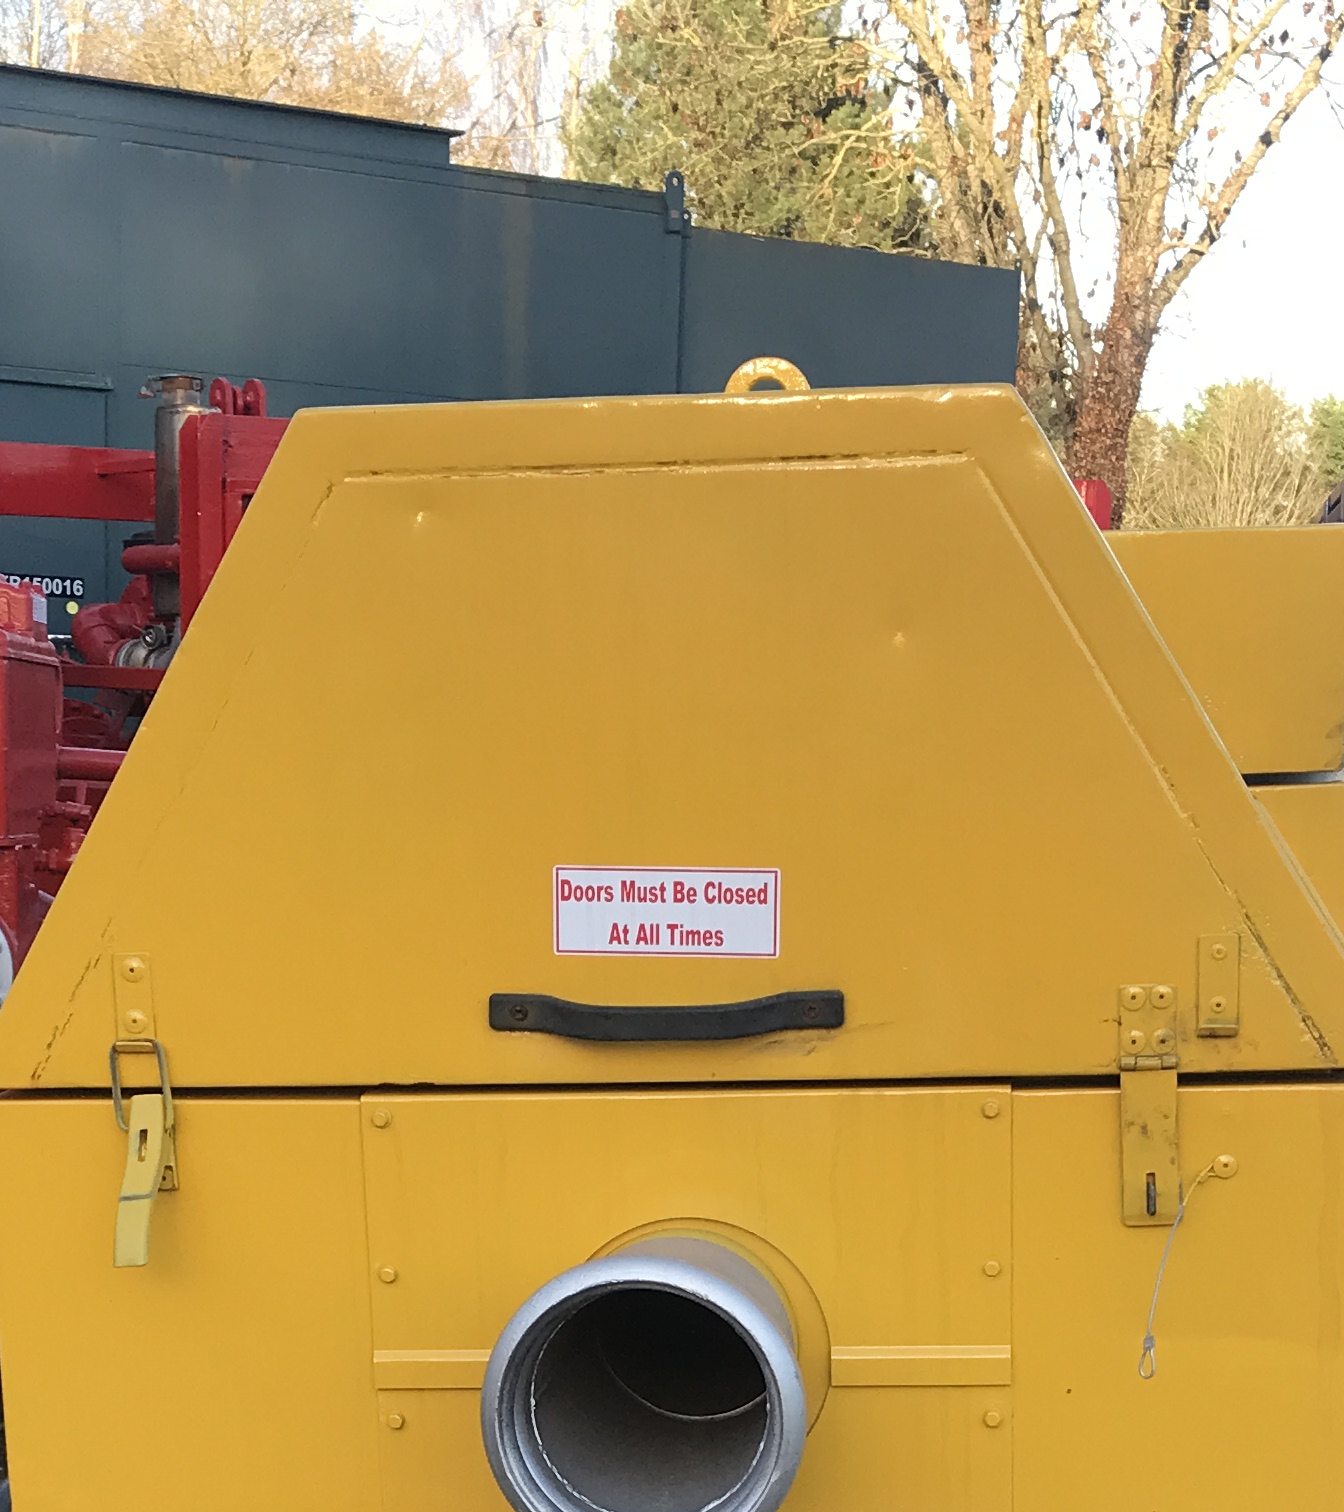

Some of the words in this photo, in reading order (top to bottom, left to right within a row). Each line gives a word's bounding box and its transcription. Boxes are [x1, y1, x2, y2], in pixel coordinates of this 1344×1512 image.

[560, 879, 614, 902] Doors
[620, 880, 666, 903] Must
[673, 881, 697, 904] Be
[704, 881, 768, 905] Closed
[608, 923, 629, 945] At
[635, 923, 660, 946] All
[666, 923, 724, 947] Times
